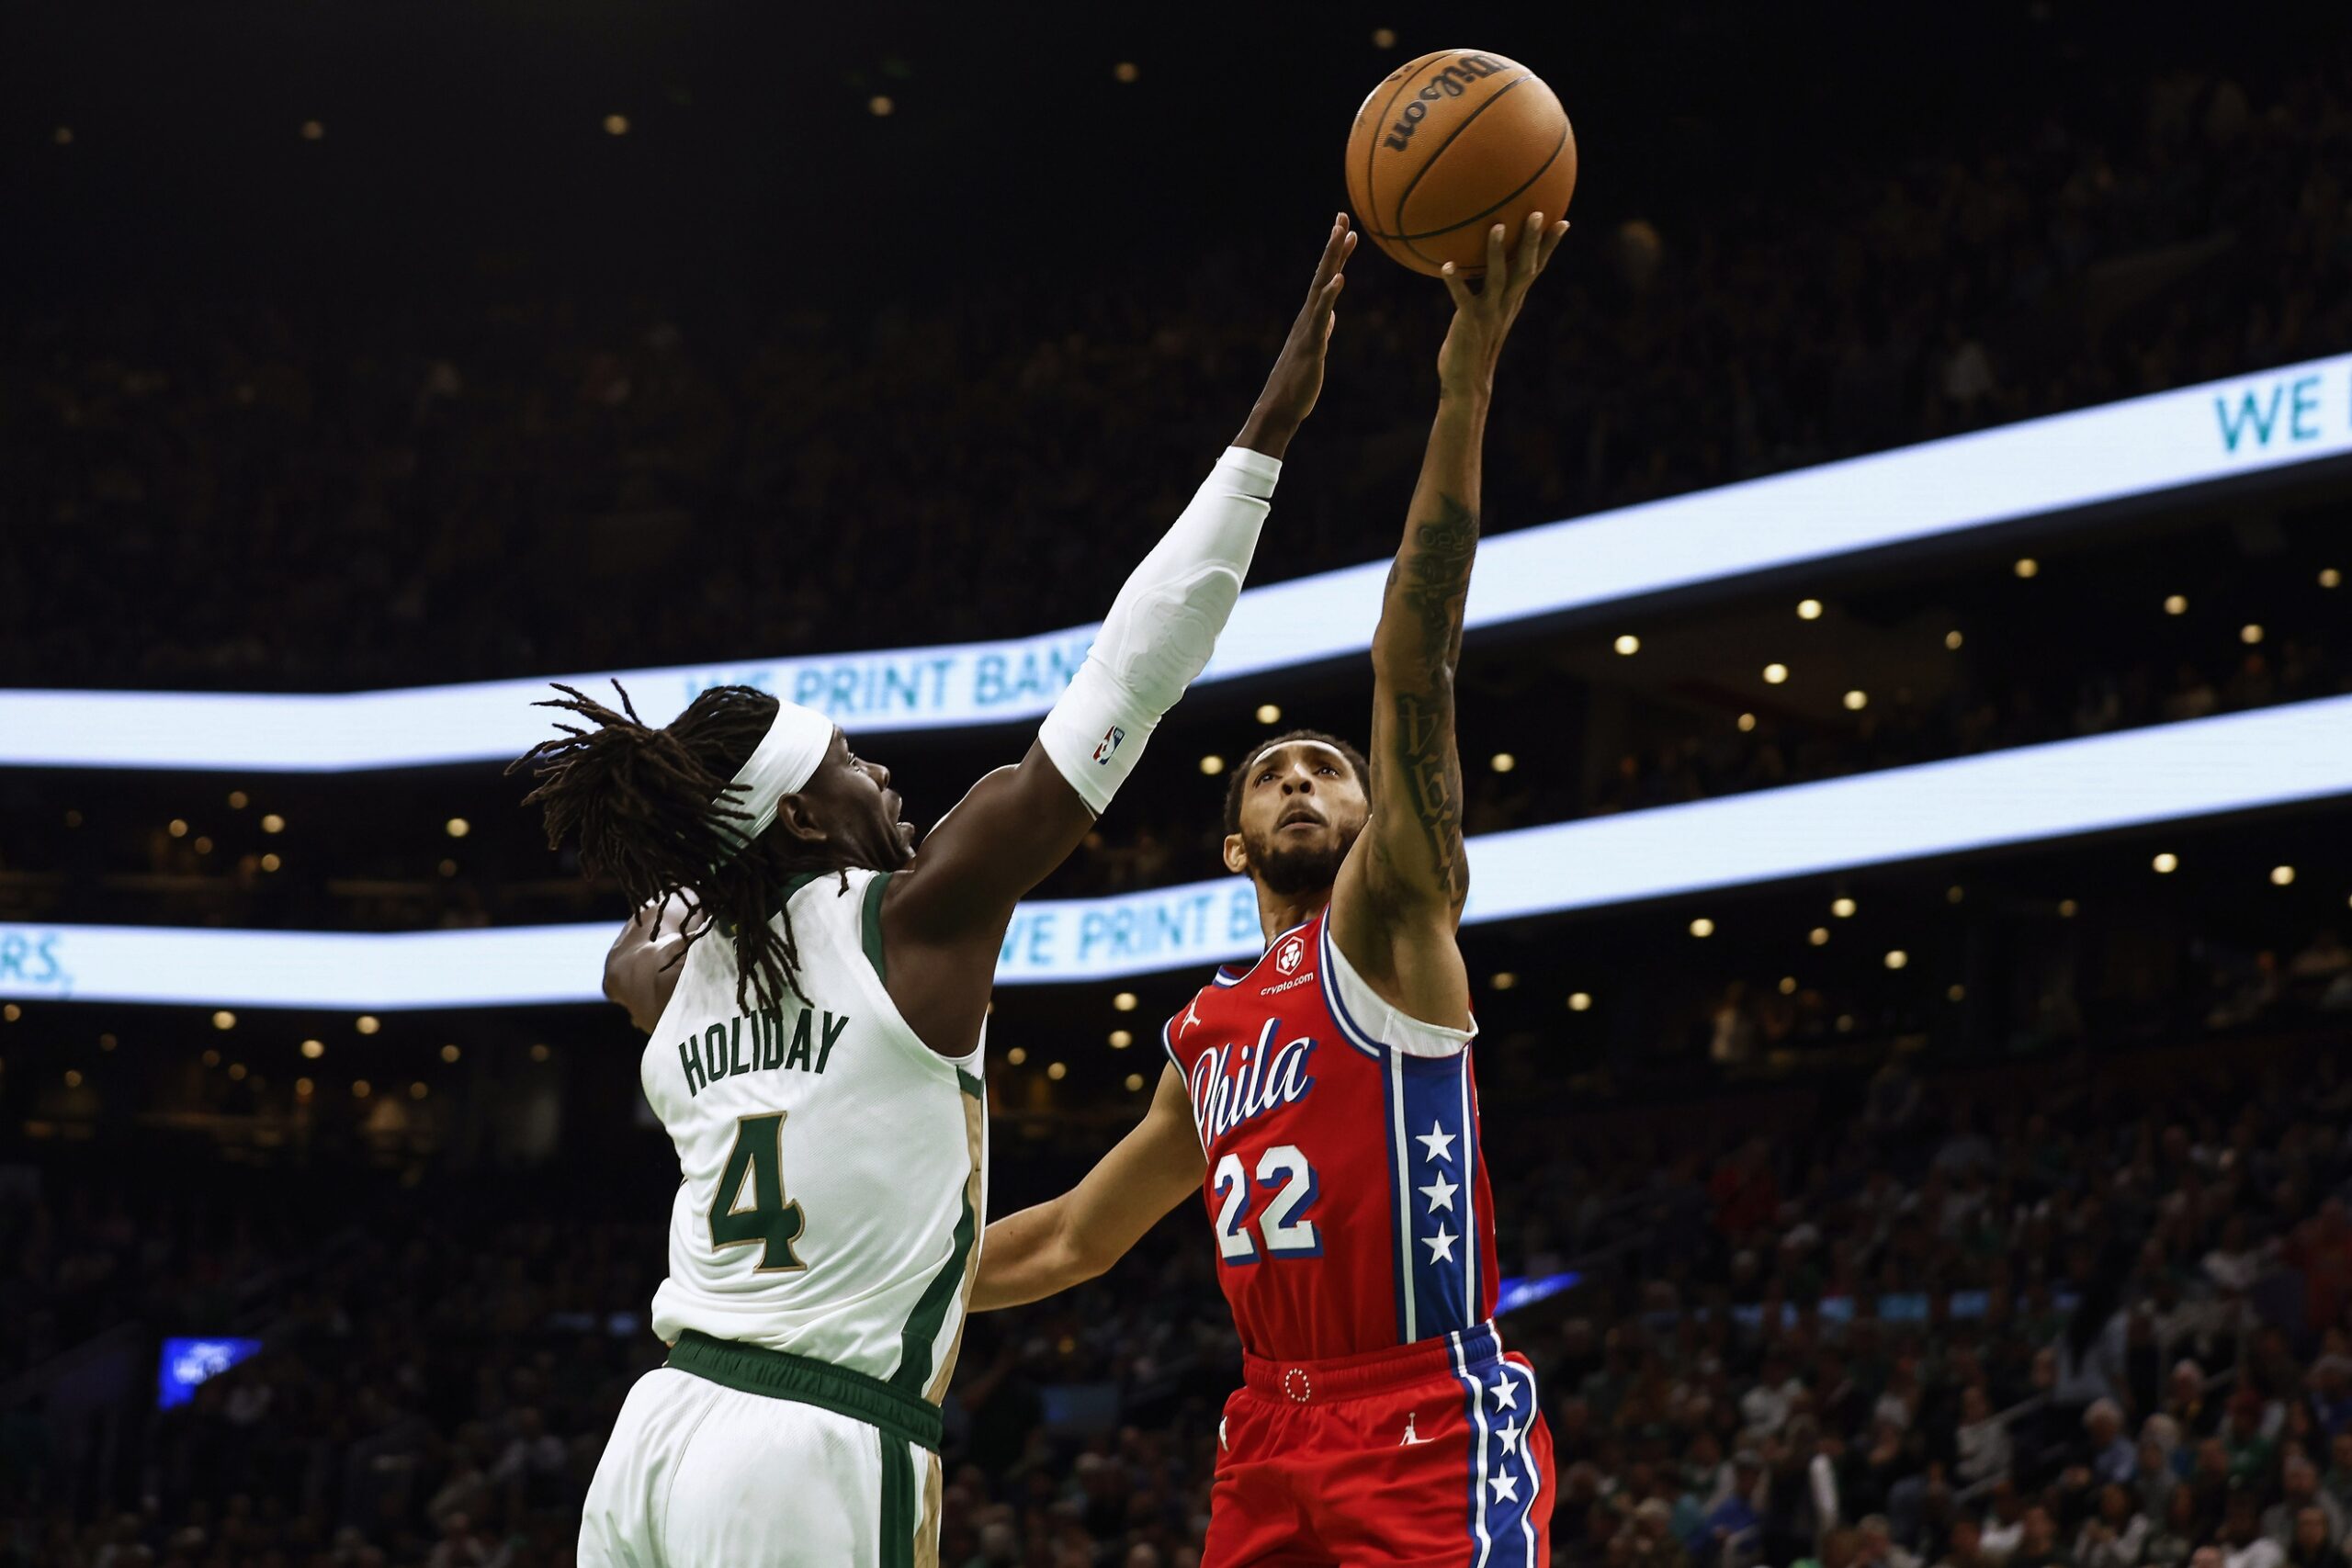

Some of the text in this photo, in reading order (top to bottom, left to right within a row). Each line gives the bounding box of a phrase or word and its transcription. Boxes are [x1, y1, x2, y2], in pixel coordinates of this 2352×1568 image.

[1384, 55, 1510, 152] Wilson
[2215, 377, 2320, 450] WE
[796, 658, 953, 715] PRINT
[976, 642, 1093, 705] BAN
[1078, 894, 1215, 960] PRINT
[1261, 972, 1314, 996] crypto.com
[678, 1008, 850, 1098] HOLIDAY
[1192, 1017, 1317, 1147] Phila
[707, 1111, 808, 1275] 4
[1214, 1145, 1324, 1268] 22
